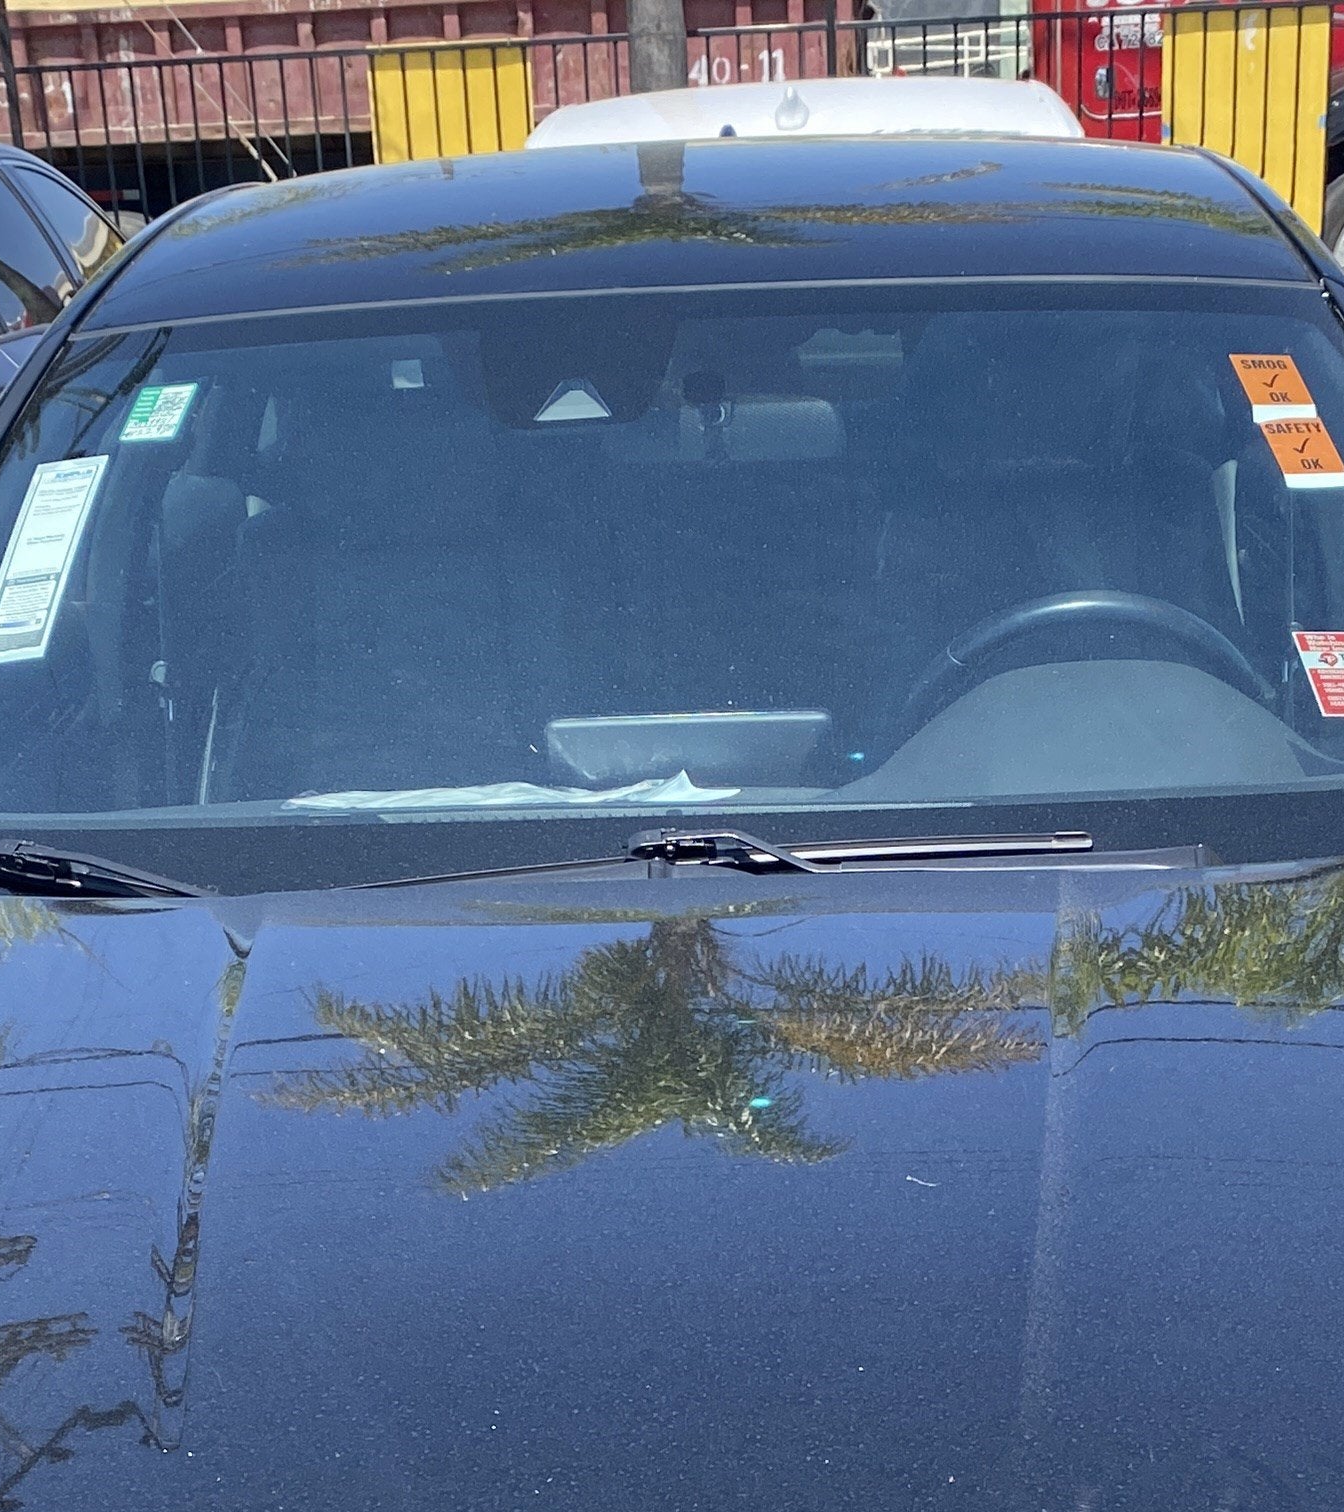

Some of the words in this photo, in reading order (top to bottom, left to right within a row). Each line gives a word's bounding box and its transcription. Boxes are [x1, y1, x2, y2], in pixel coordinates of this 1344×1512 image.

[1240, 360, 1288, 370] SMOG
[1269, 391, 1292, 402] OK
[1264, 422, 1322, 434] SAFETY
[1300, 458, 1323, 470] OK
